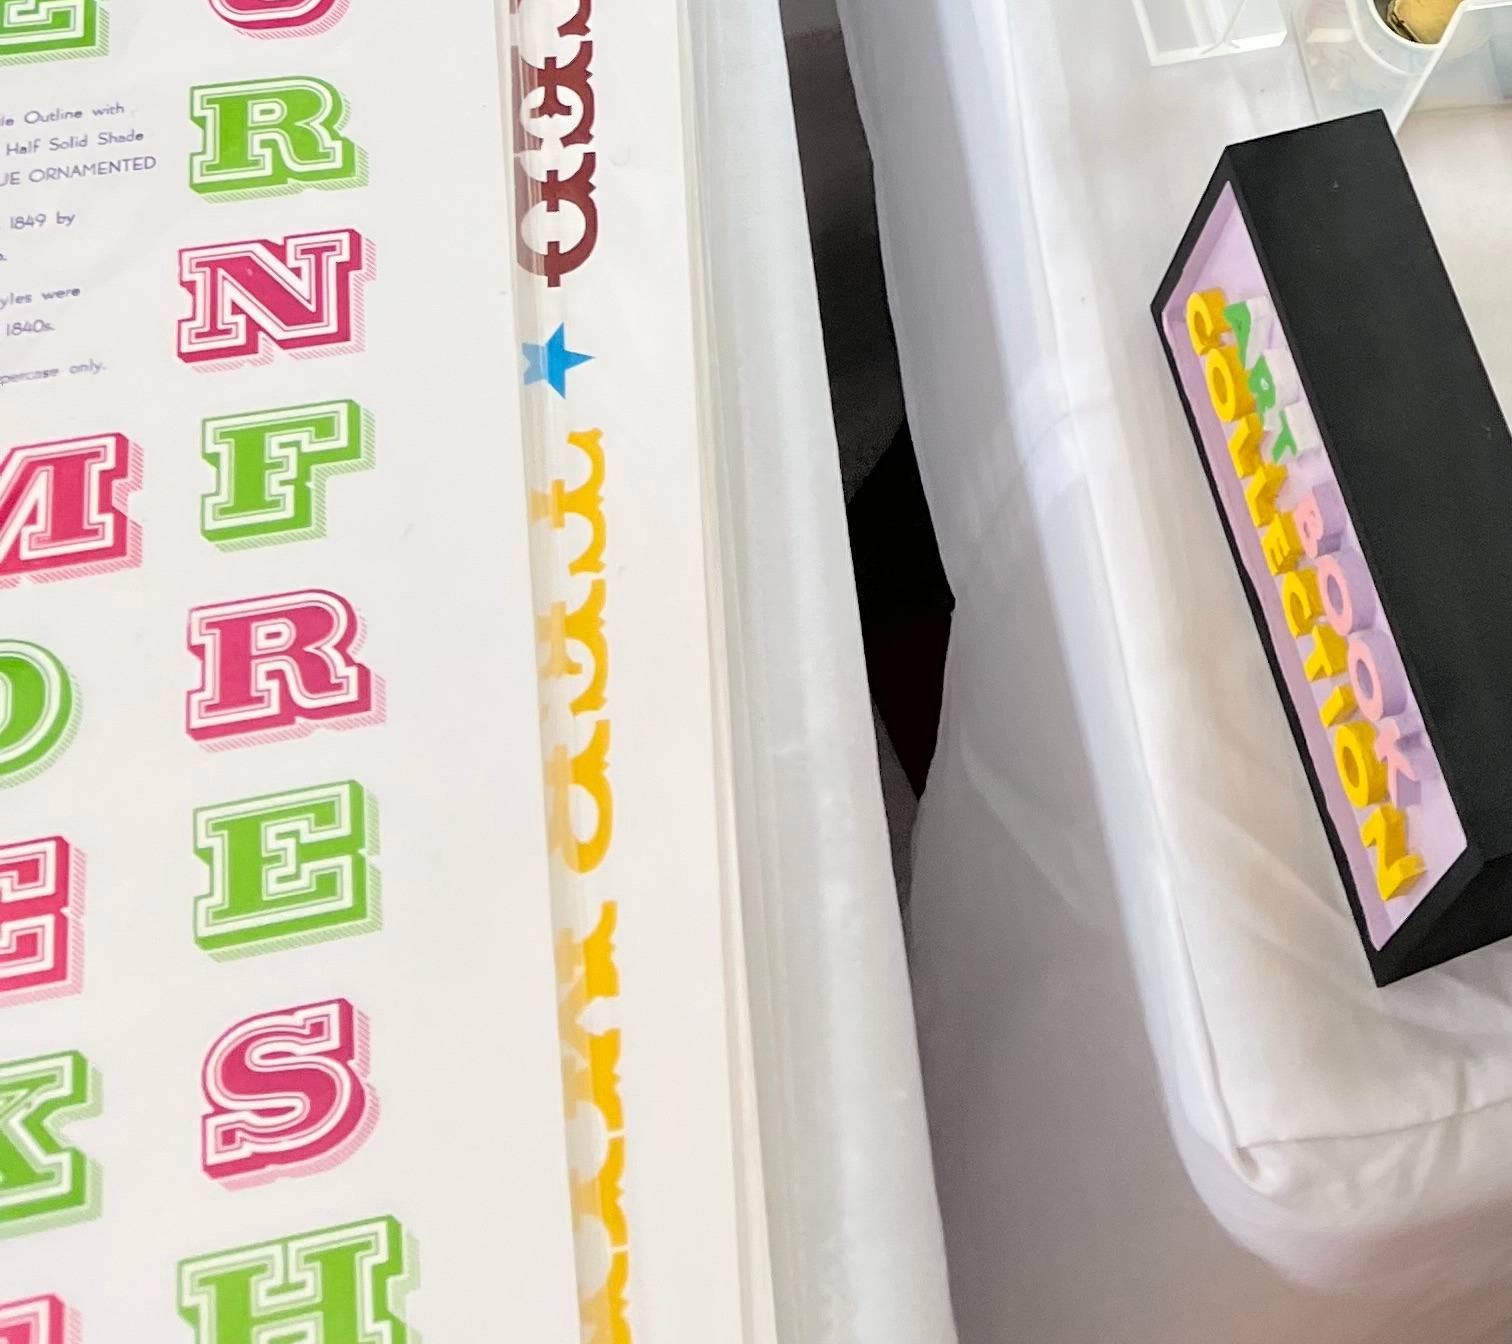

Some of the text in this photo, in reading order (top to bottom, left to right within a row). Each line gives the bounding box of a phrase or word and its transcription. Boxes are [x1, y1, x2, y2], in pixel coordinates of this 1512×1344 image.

[24, 107, 83, 124] Outline
[92, 102, 125, 116] with
[6, 129, 144, 156] Half Solid Shade
[28, 156, 157, 183] ORNAMENTED
[10, 211, 76, 230] 1849 by
[41, 287, 80, 301] were
[1222, 296, 1441, 808] ART BOOK
[1185, 288, 1429, 902] COLLECTION
